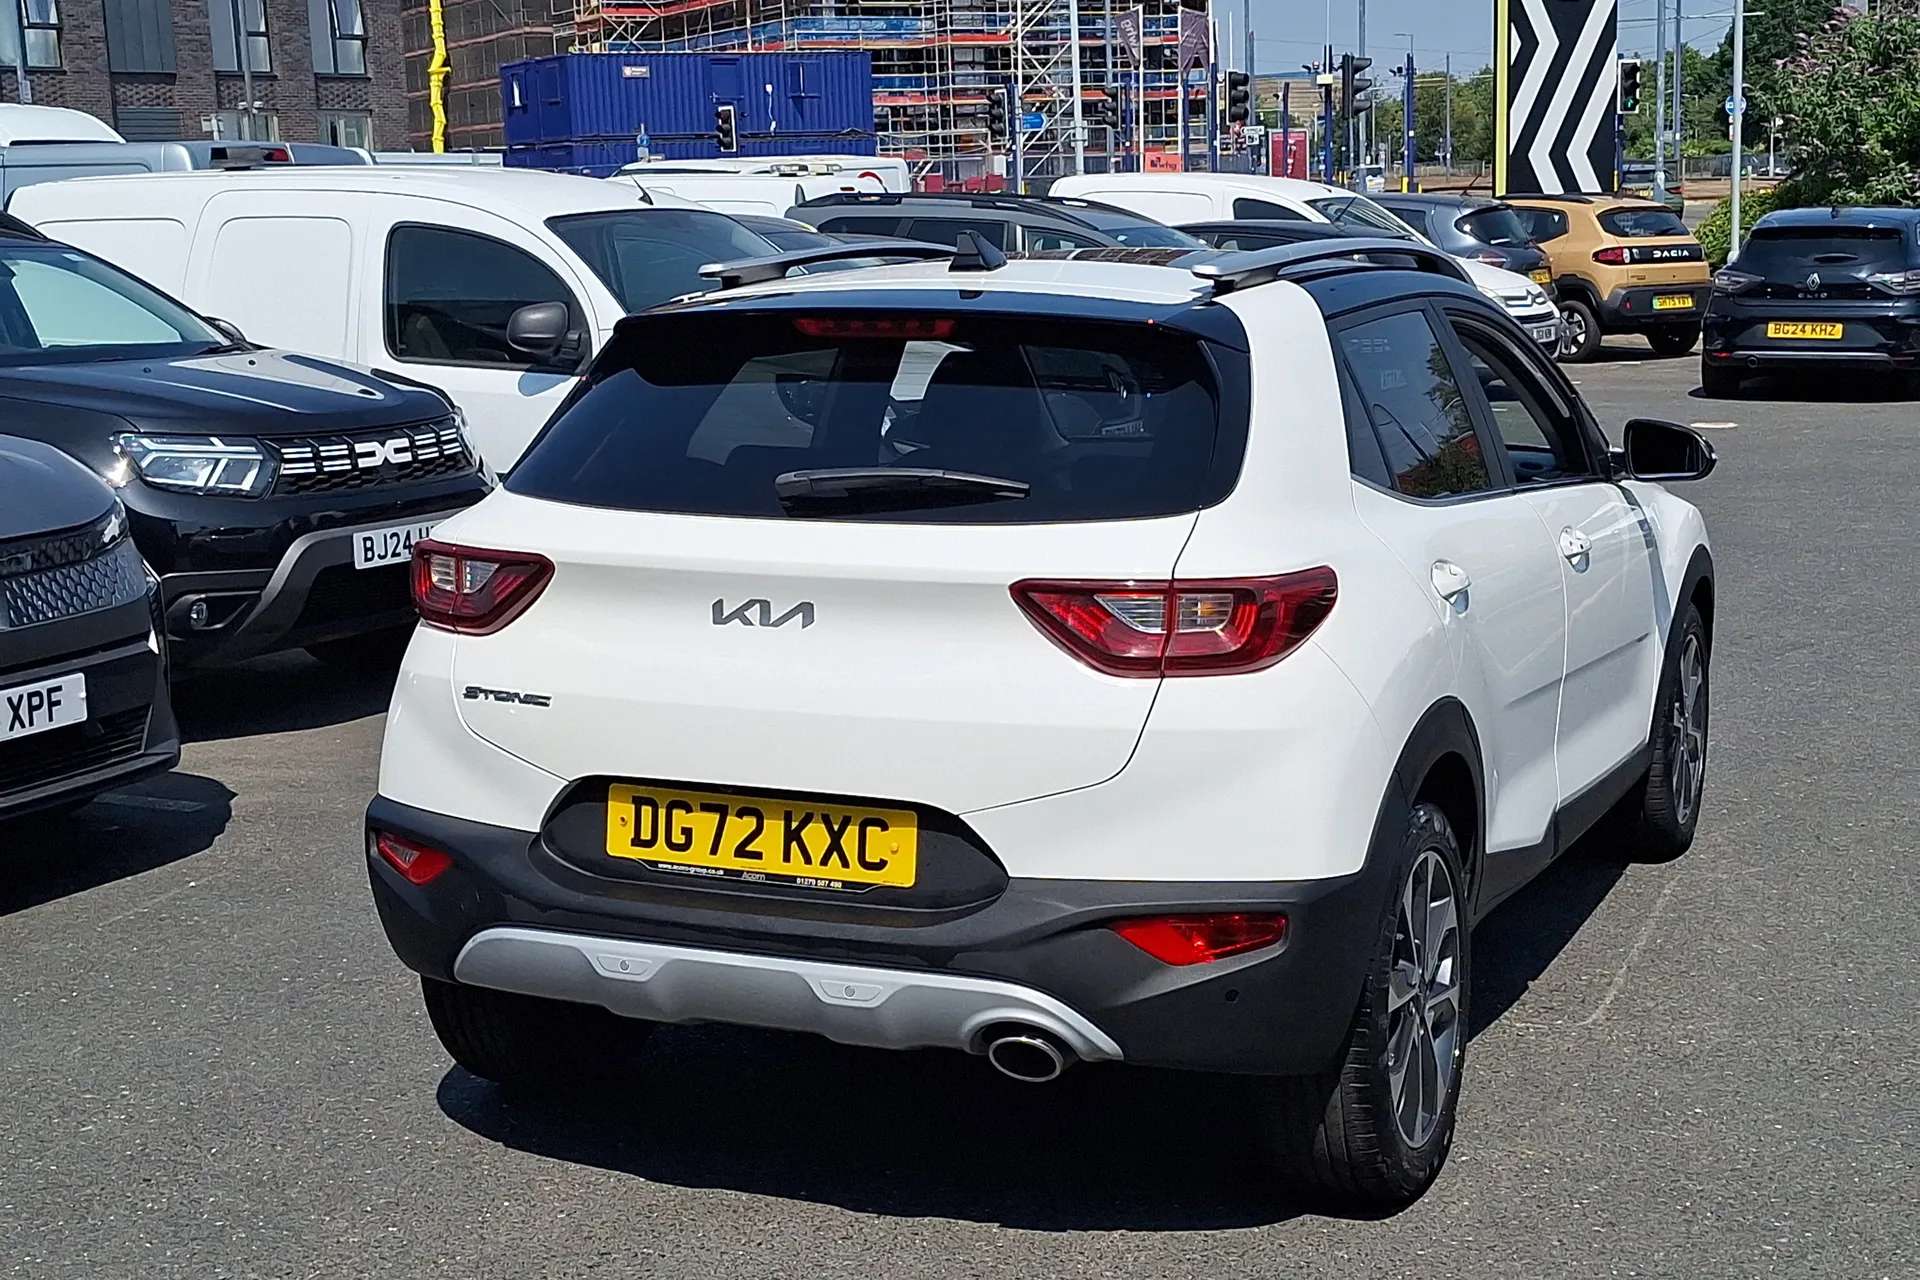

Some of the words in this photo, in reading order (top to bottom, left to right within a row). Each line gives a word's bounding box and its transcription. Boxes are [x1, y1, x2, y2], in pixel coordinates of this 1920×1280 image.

[1653, 249, 1690, 258] DACIA
[1774, 323, 1807, 335] BG24
[1811, 324, 1837, 336] KHZ
[362, 529, 413, 562] BJ24
[712, 598, 815, 629] KIA
[6, 684, 63, 732] XPF
[462, 686, 552, 707] STONIC
[630, 795, 765, 861] DG72
[782, 809, 890, 872] KXC
[741, 871, 766, 881] Acorn
